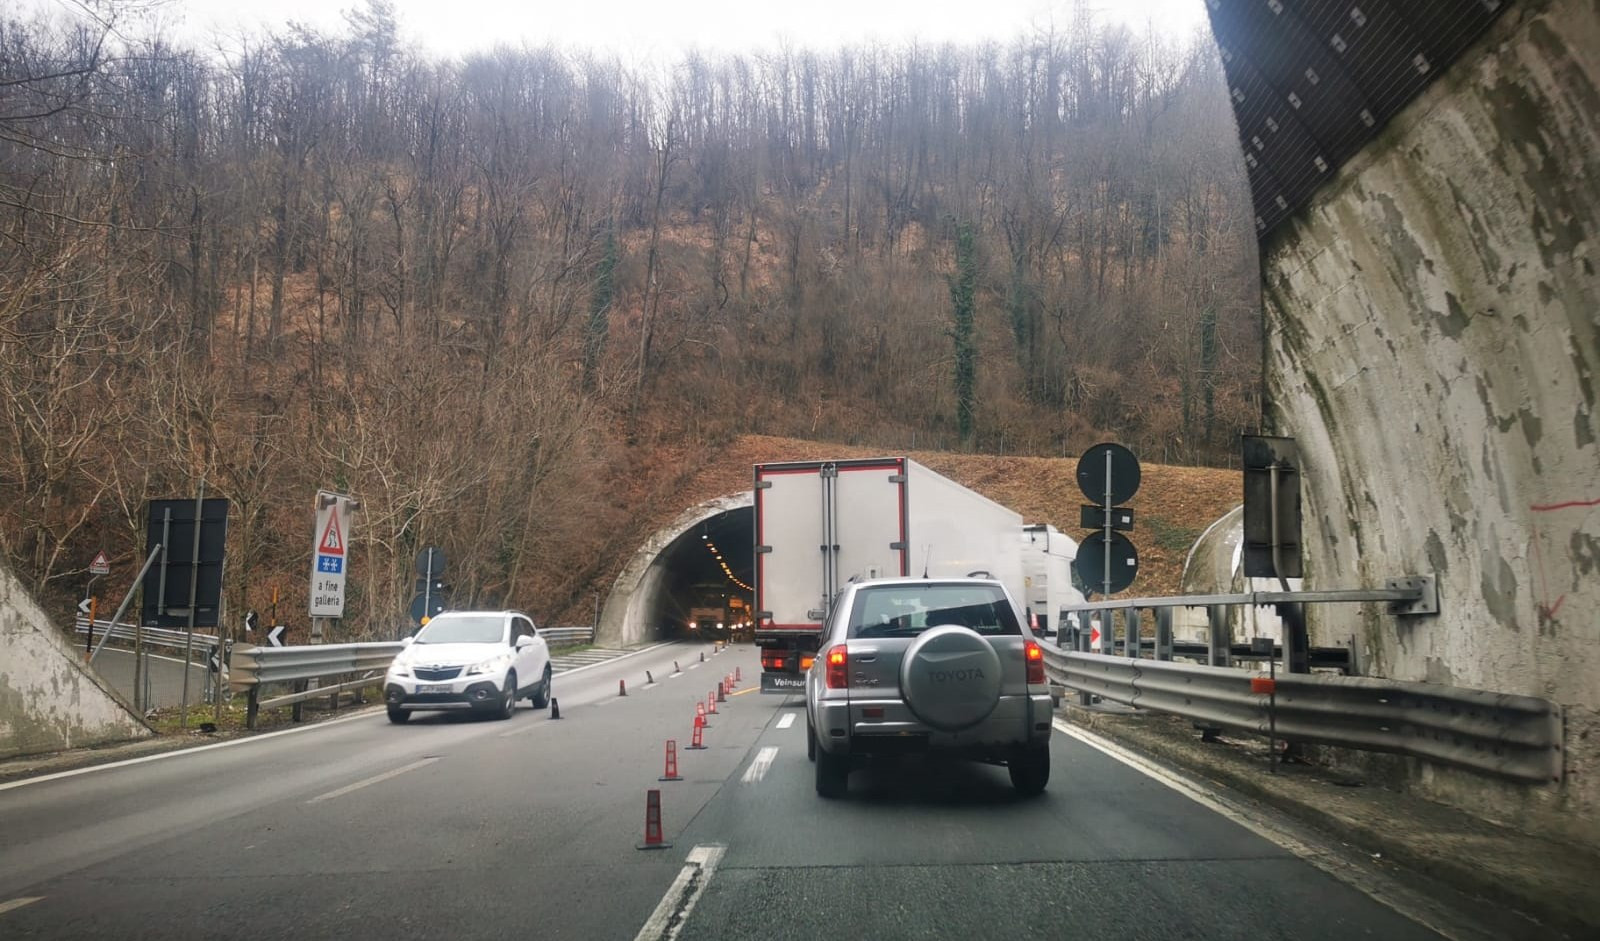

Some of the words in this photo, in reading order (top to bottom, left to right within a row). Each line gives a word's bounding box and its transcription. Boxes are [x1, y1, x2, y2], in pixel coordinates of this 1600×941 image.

[318, 582, 322, 591] a
[325, 580, 338, 592] fine
[314, 595, 340, 607] galleria
[928, 668, 985, 683] TOYOTA
